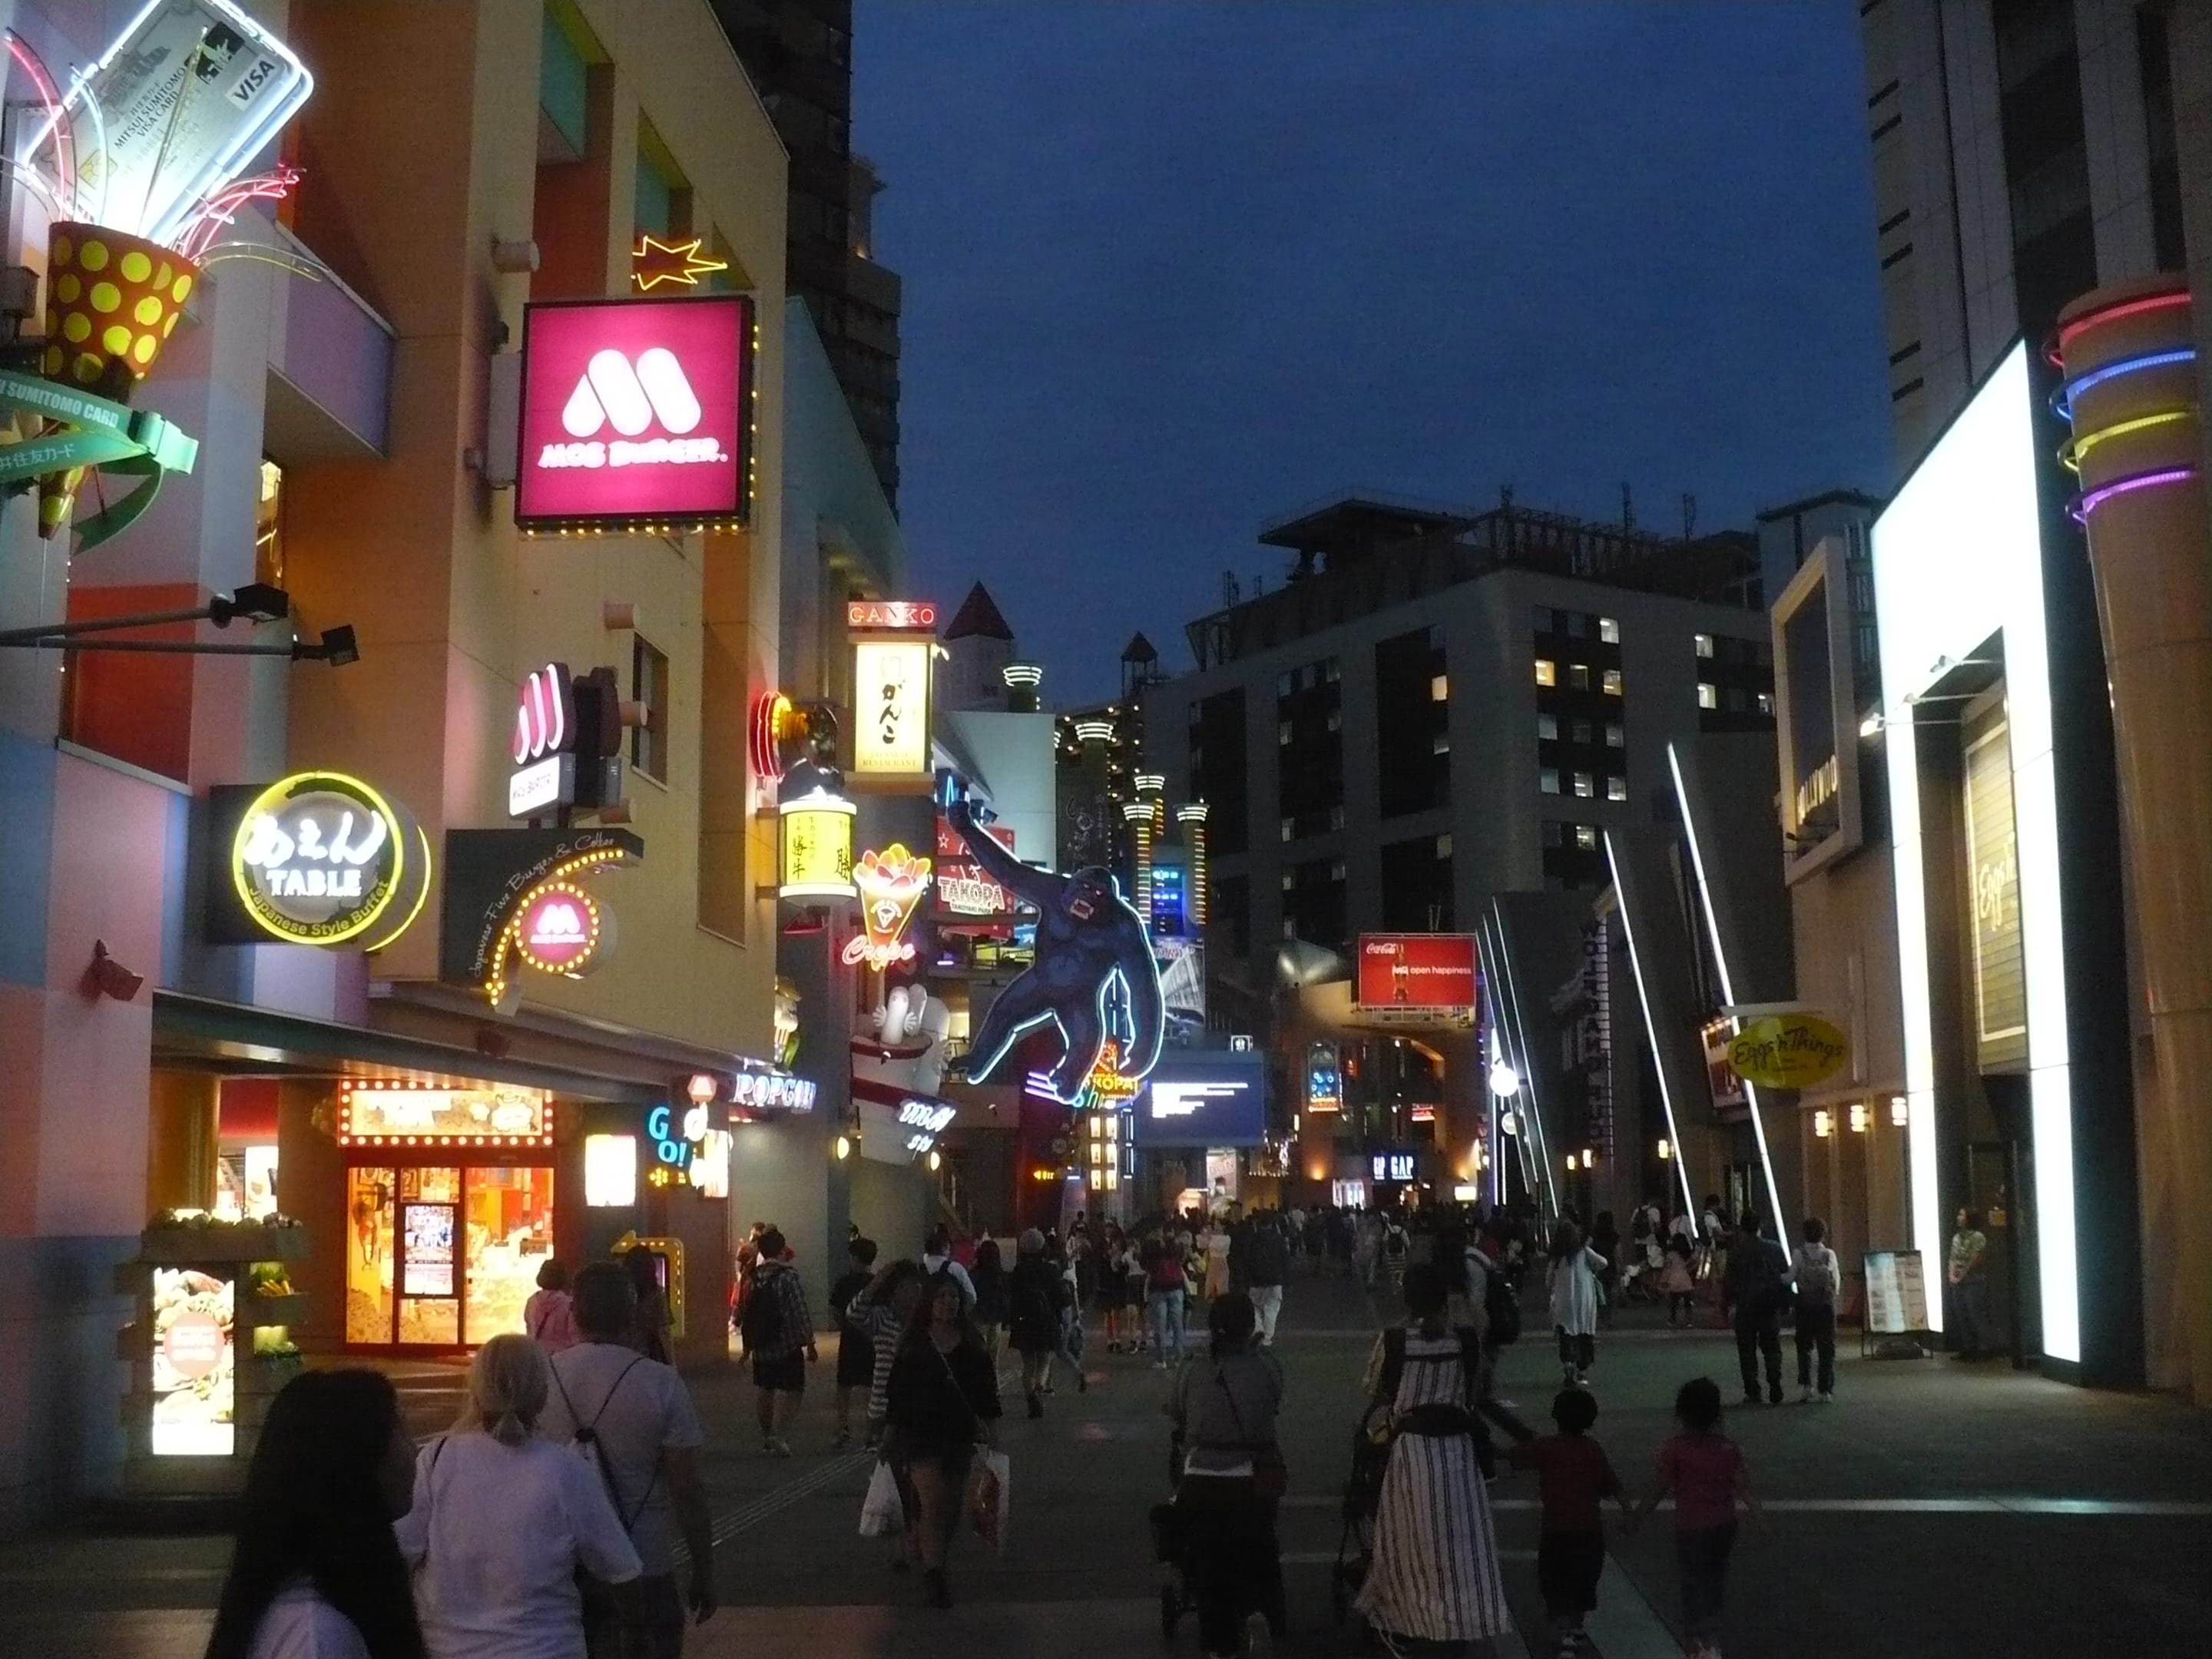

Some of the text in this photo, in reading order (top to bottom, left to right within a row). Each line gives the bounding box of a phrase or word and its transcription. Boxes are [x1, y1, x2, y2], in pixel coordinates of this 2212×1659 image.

[233, 60, 276, 102] VISA
[114, 113, 144, 149] MITSUI
[141, 66, 187, 118] SUMITOMO
[137, 115, 161, 137] VISA
[156, 91, 180, 117] CARD
[7, 382, 82, 416] SUMITOMO
[83, 404, 120, 428] CARD
[849, 607, 935, 624] GANKO
[266, 869, 363, 897] TABLE
[505, 857, 554, 892] Burger
[555, 843, 572, 859] &
[250, 881, 389, 936] Japanese Style Buffet
[939, 877, 1005, 910] TAKOPA
[842, 935, 916, 965] Crepe
[1410, 967, 1431, 975] open
[1432, 965, 1472, 975] happiness
[1734, 1041, 1774, 1071] Eggs
[1784, 1025, 1843, 1068] Things
[1391, 1155, 1414, 1175] GAP
